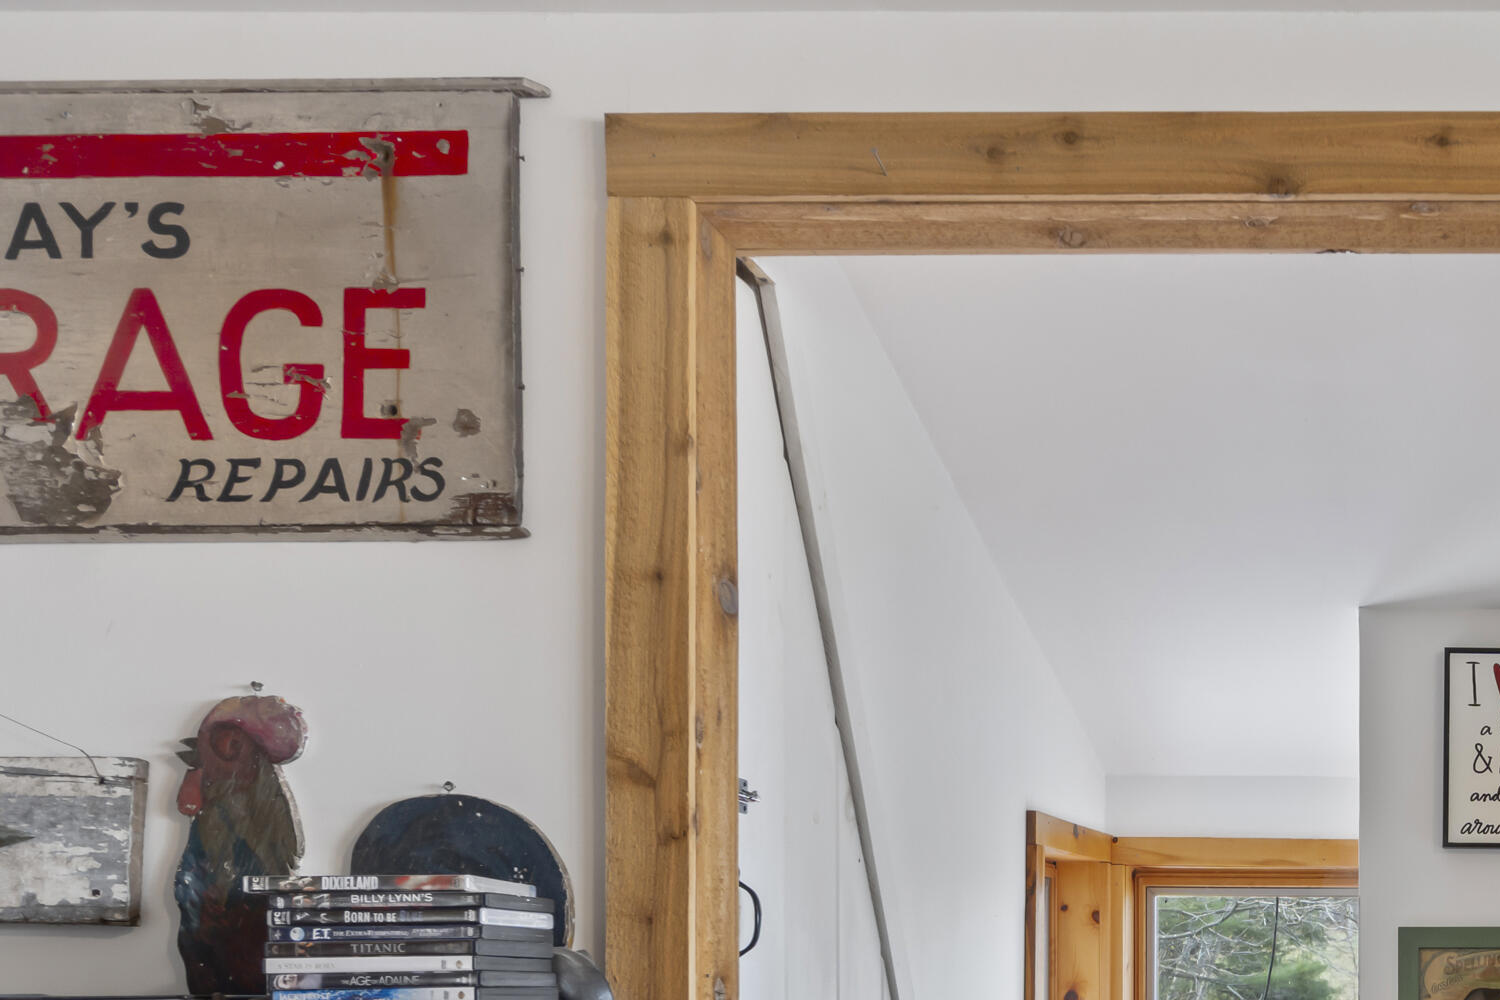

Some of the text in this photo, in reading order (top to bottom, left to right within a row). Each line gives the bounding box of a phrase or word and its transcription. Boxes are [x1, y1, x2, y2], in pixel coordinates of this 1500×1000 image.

[166, 456, 447, 503] REPAIRS
[1466, 661, 1481, 707] I
[1480, 725, 1493, 736] a
[1472, 743, 1493, 774] &
[322, 877, 378, 890] DIXIELAND
[351, 893, 433, 904] BILLY LYNN'S
[344, 911, 397, 923] BORN TO BE
[350, 943, 406, 953] TITANIC
[349, 975, 420, 986] AGE ADALINE
